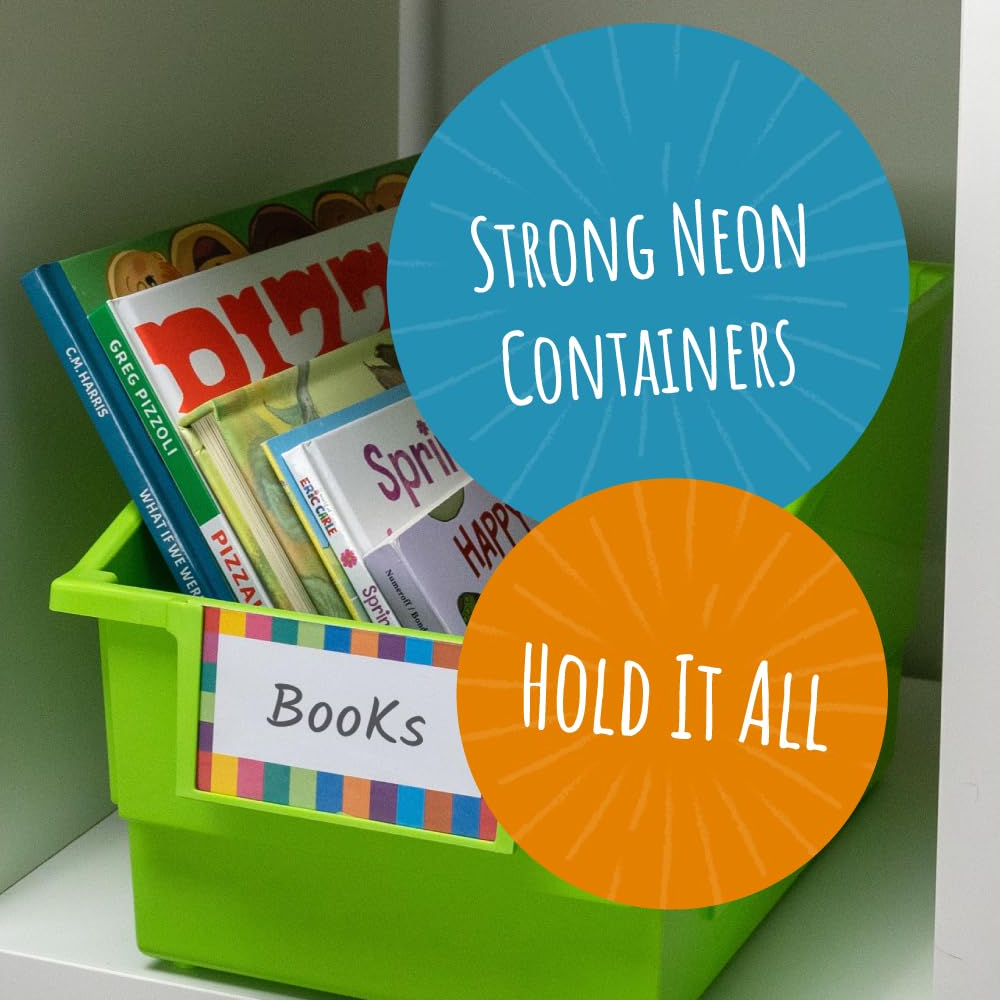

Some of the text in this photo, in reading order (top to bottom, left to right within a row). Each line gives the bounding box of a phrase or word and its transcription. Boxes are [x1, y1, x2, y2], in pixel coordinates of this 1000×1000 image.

[65, 347, 109, 418] C.M. HARRIS
[109, 339, 178, 456] GREG PIZZOLI
[139, 487, 168, 529] WHAT
[161, 530, 173, 544] IF
[168, 543, 186, 567] WE
[316, 505, 337, 536] CARLE
[385, 569, 411, 607] Numeroff
